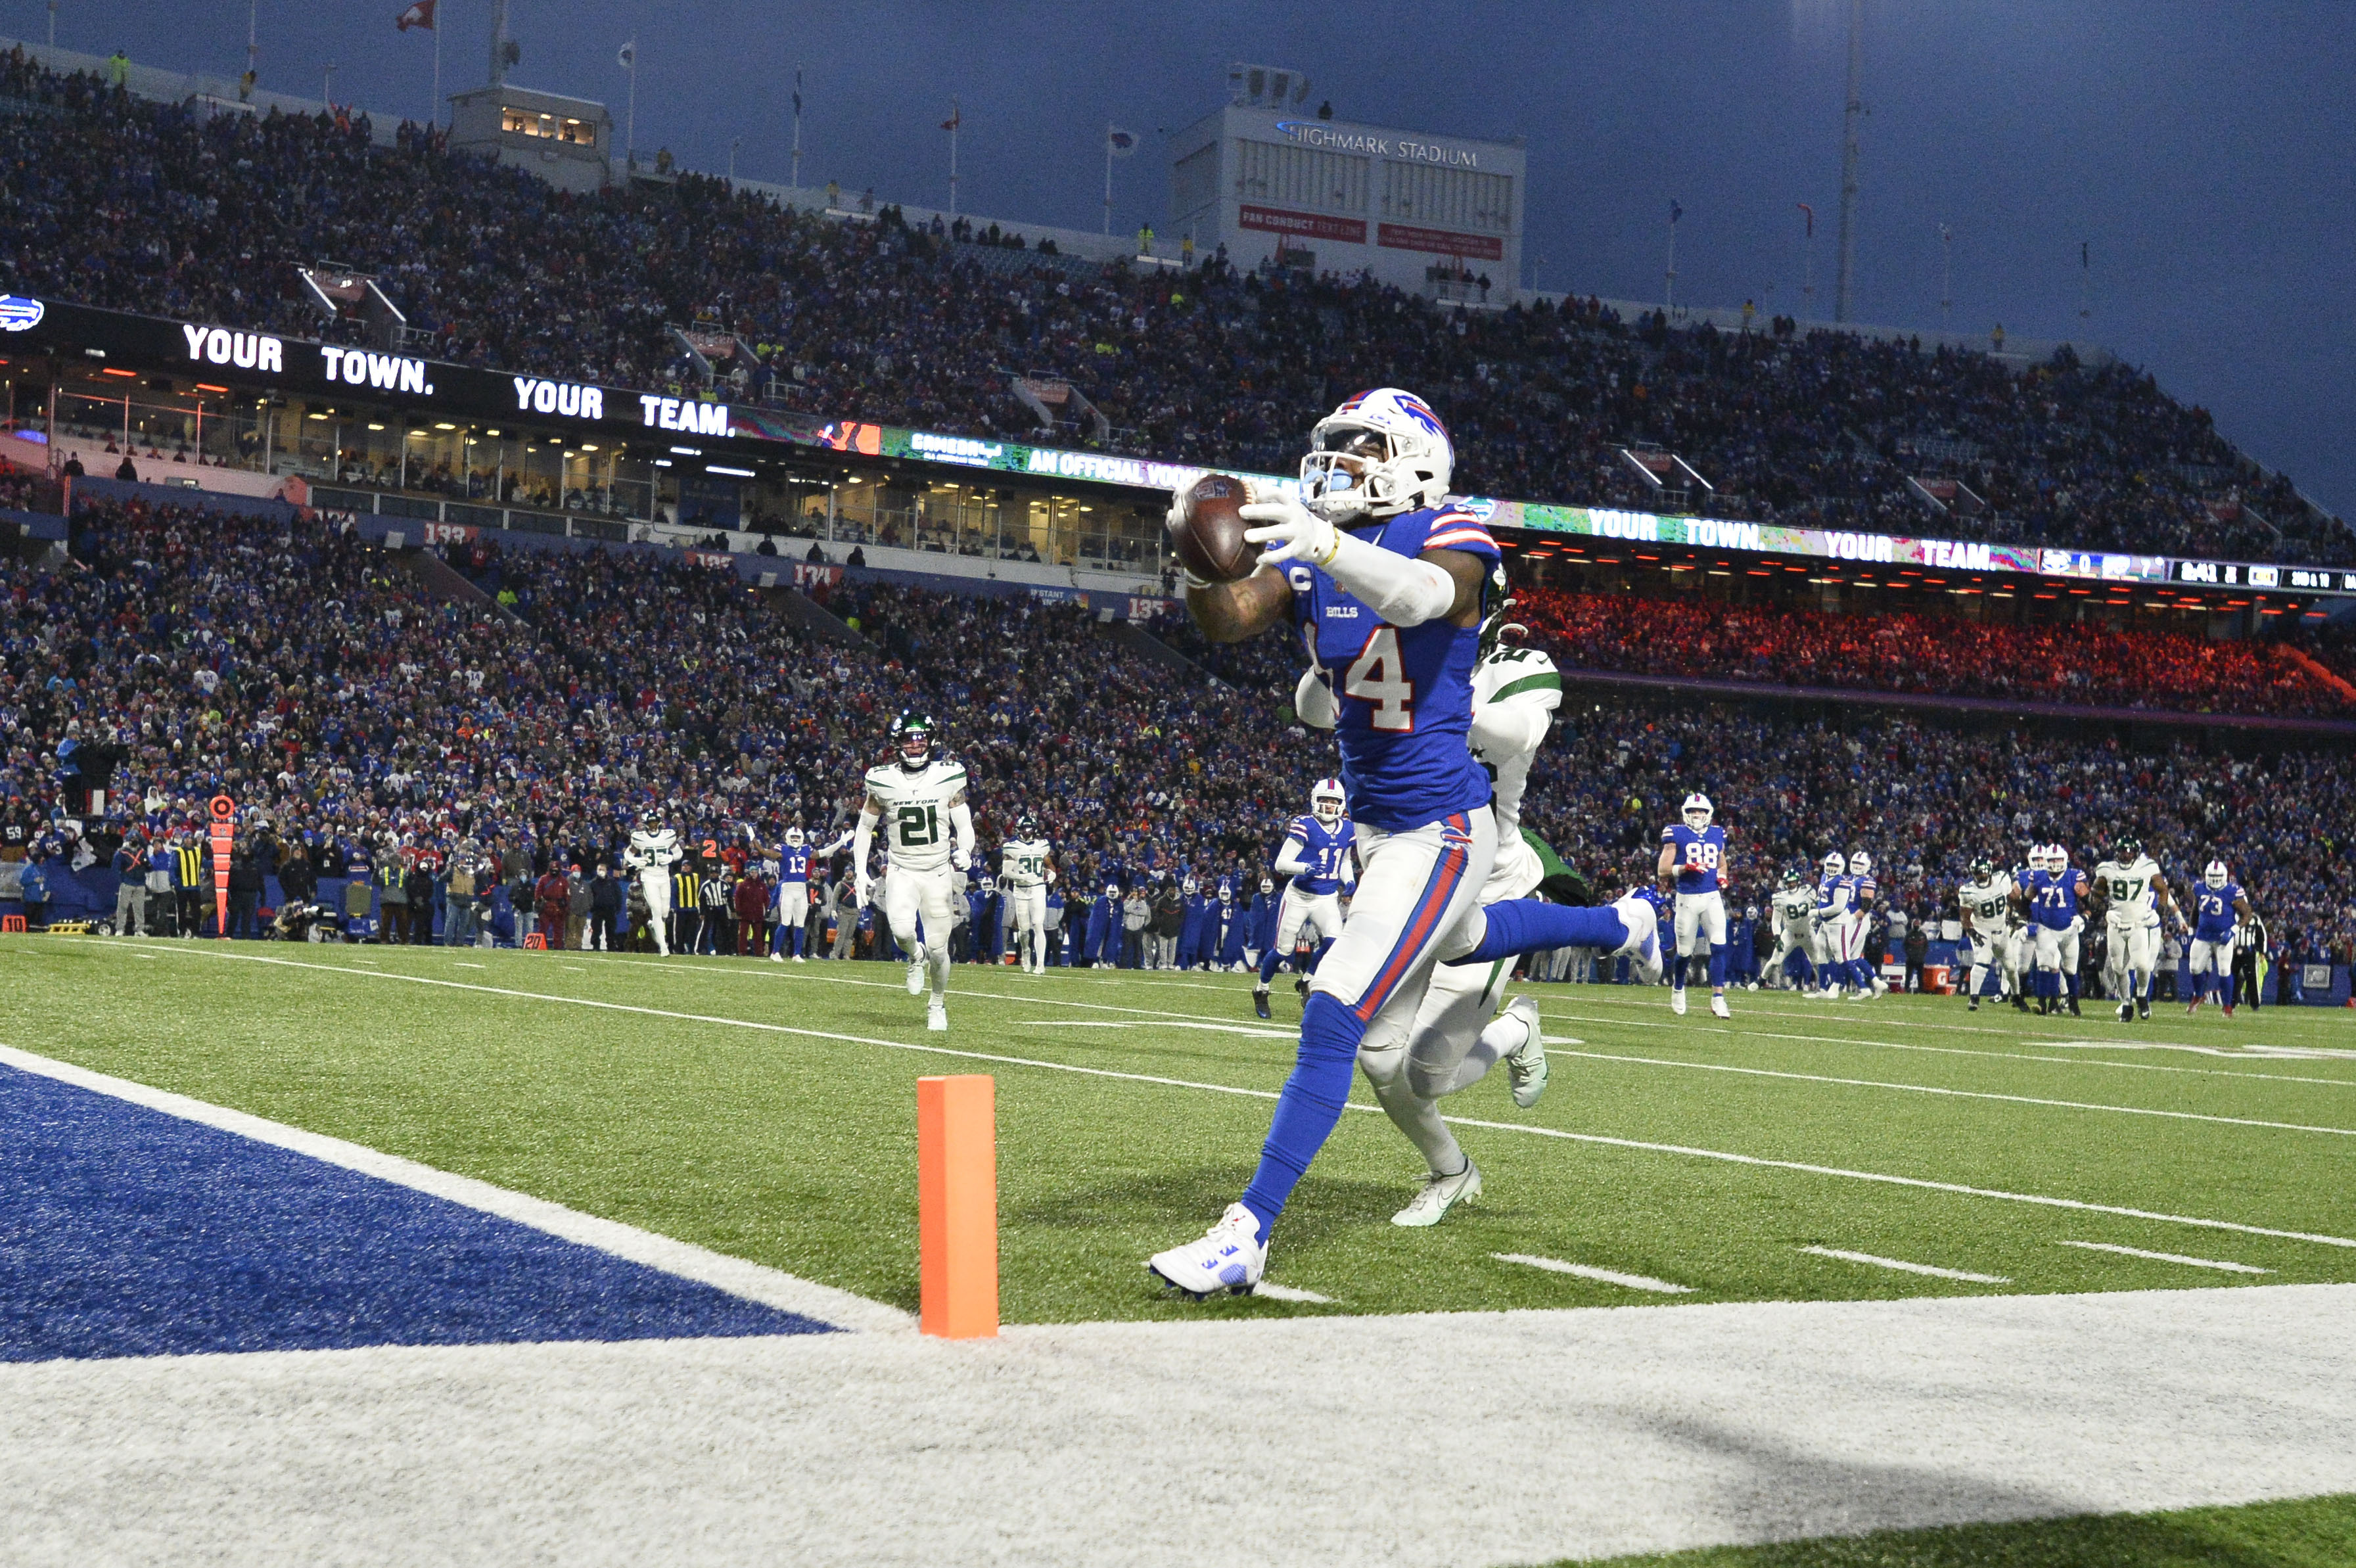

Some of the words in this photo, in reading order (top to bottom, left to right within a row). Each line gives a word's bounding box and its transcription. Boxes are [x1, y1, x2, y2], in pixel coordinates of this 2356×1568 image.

[1289, 124, 1389, 155] HIGHMARK
[1397, 141, 1477, 168] STADIUM
[1243, 212, 1263, 223] FAN
[1265, 215, 1314, 230] CONDUCT
[183, 324, 282, 373] YOUR
[321, 346, 434, 395] TOWN.
[513, 377, 603, 419] YOUR
[639, 394, 735, 438] TEAM.
[1028, 450, 1057, 473] AN
[1059, 453, 1144, 485] OFFICIAL
[1587, 507, 1657, 542] YOUR
[1684, 518, 1765, 551] TOWN.
[1824, 530, 1893, 563] YOUR
[1920, 540, 1996, 571] TEAM.
[2079, 555, 2091, 573] 0
[2140, 558, 2152, 578] 7
[1289, 566, 1312, 591] C
[1129, 597, 1165, 619] 135
[1326, 606, 1358, 618] BILLS
[915, 798, 940, 806] YORK
[6, 826, 22, 840] 59
[898, 804, 939, 846] 21
[702, 839, 717, 858] 2
[1125, 833, 1136, 843] 91
[789, 856, 806, 874] 13
[972, 858, 981, 869] 14
[1314, 848, 1343, 880] 11
[1685, 842, 1719, 869] 88
[1019, 856, 1044, 878] 30
[2041, 887, 2067, 908] 71
[2112, 879, 2144, 901] 97
[1221, 908, 1232, 919] 41
[2200, 894, 2223, 916] 73
[1937, 971, 1947, 986] G
